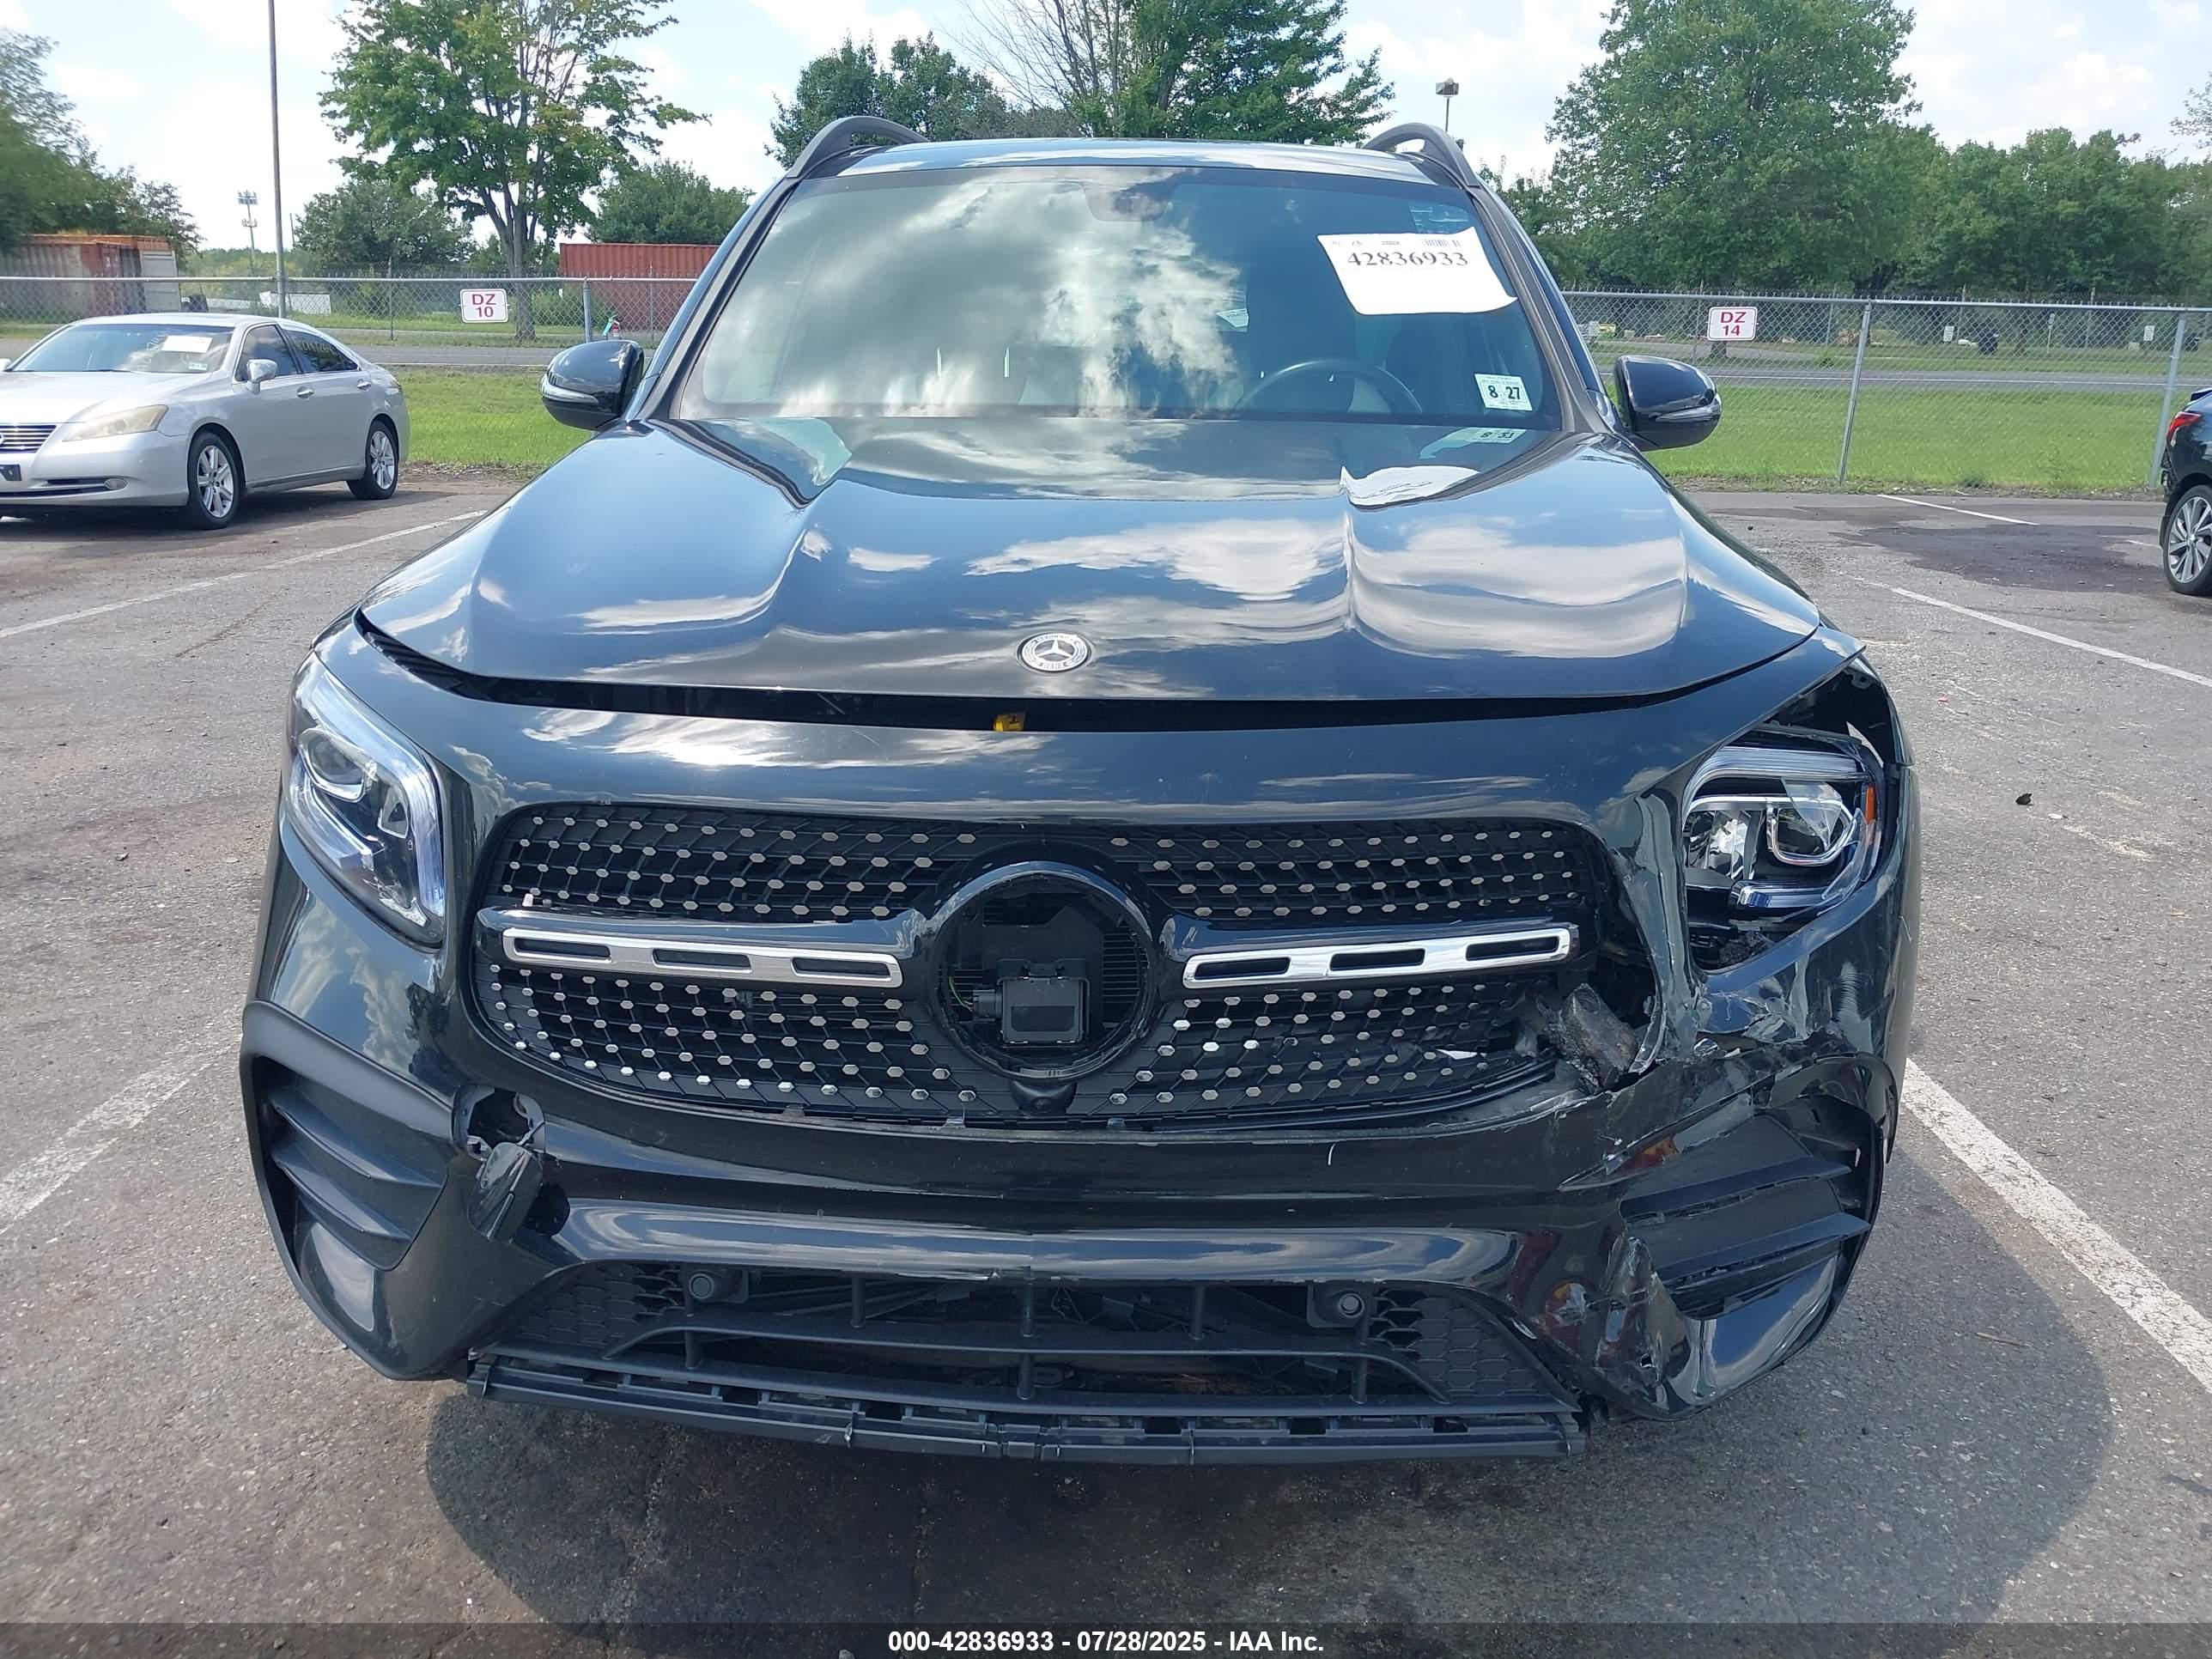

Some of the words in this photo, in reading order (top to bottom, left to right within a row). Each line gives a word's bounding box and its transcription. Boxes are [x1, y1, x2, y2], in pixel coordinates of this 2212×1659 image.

[1347, 251, 1468, 266] 42836933
[471, 294, 496, 305] DZ
[475, 306, 494, 318] 10
[1720, 311, 1747, 323] DZ
[1723, 325, 1741, 336] 14
[1487, 385, 1498, 398] 8
[1505, 386, 1521, 400] 27
